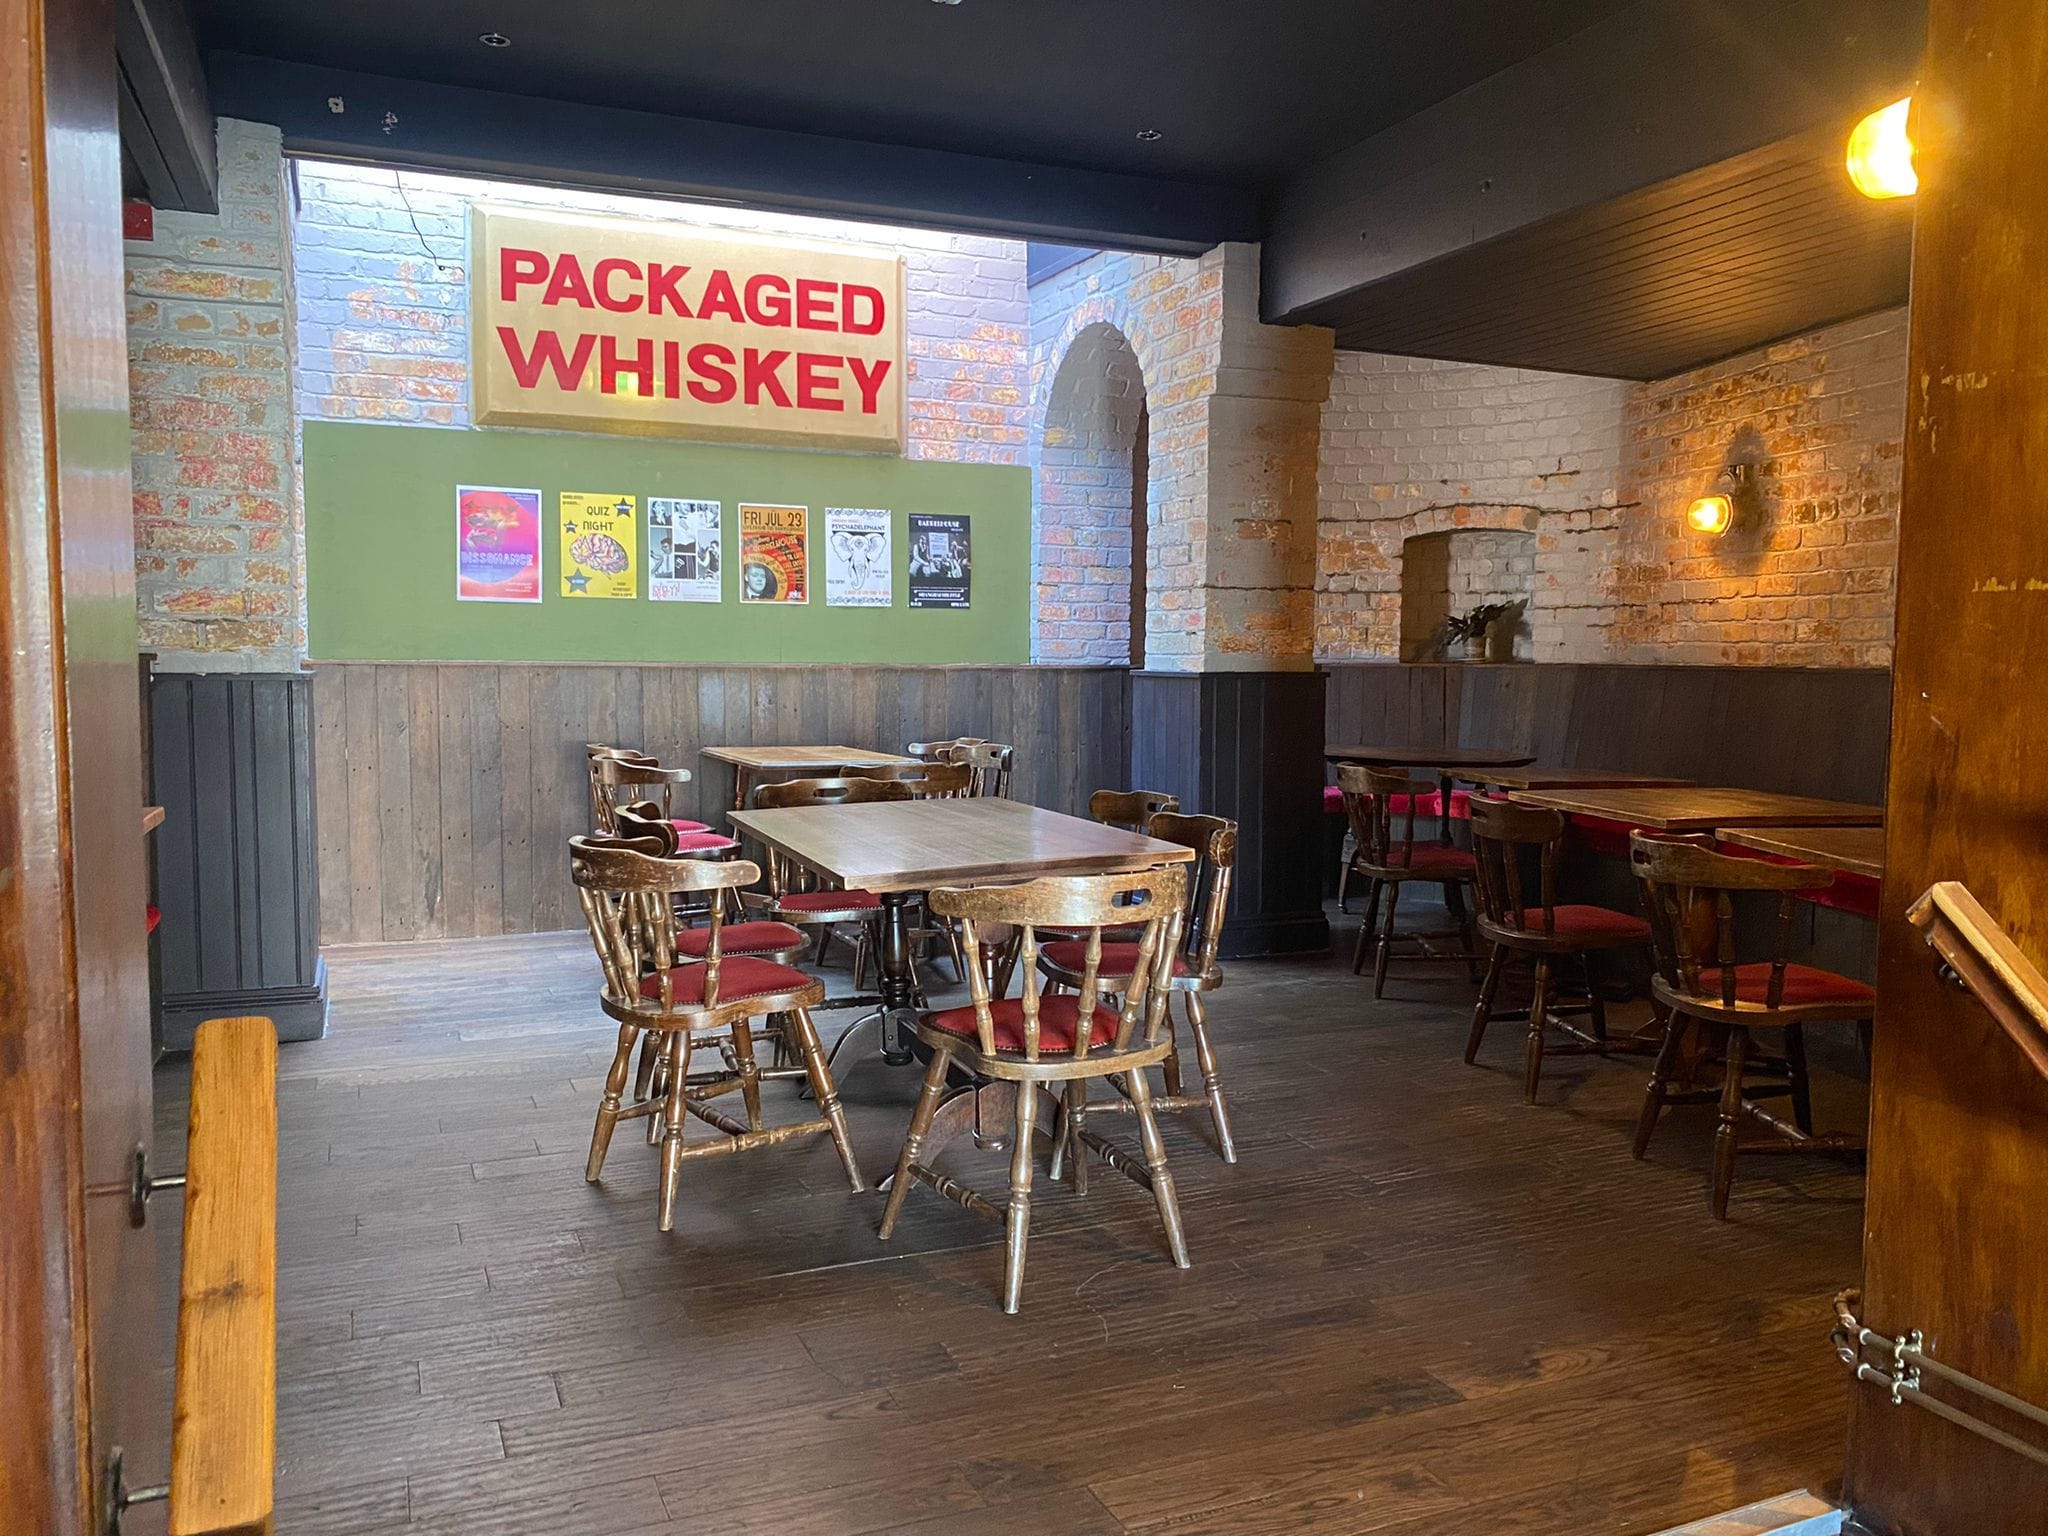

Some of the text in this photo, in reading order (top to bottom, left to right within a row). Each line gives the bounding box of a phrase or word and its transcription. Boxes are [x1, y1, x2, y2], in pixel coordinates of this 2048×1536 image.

[500, 247, 885, 336] PACKAGED
[496, 326, 892, 414] WHISKEY
[586, 505, 610, 516] QUIZ
[582, 520, 614, 531] NIGHT
[743, 511, 802, 527] FRI JUL 23
